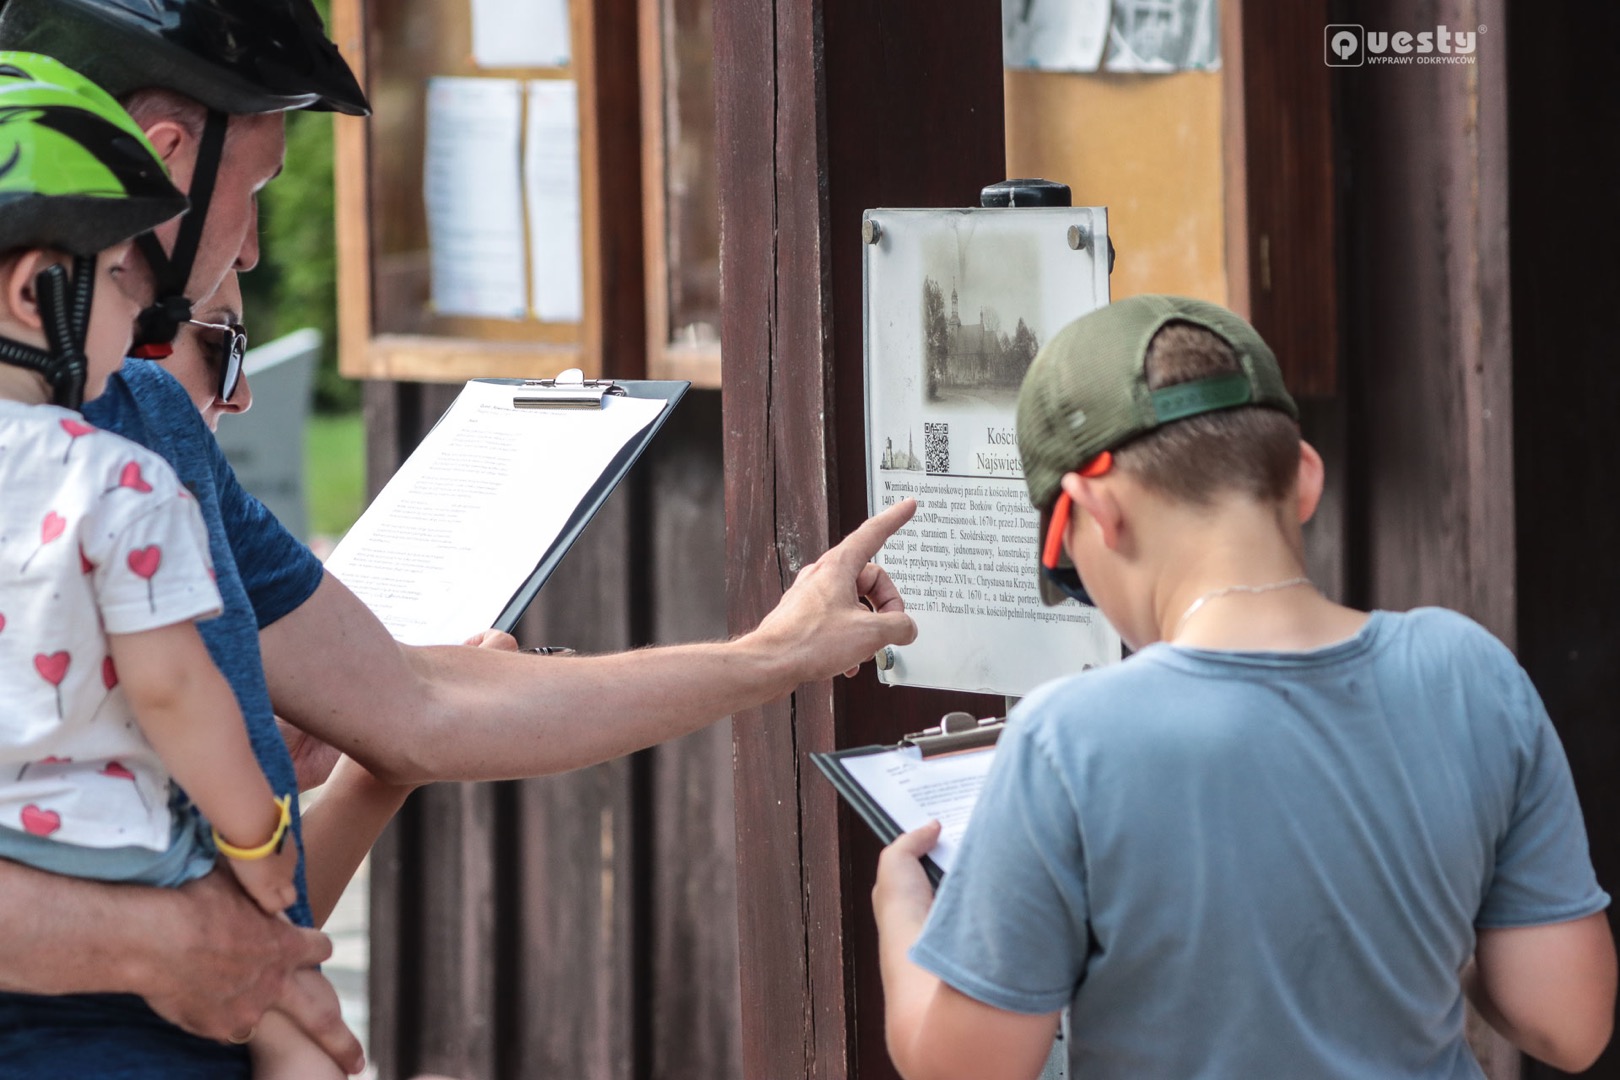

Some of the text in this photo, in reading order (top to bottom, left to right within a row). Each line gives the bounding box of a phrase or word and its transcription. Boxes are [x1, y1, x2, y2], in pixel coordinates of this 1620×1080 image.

[884, 482, 913, 492] Wzmianka
[919, 482, 963, 498] jednowioskowej
[965, 486, 983, 498] parafii
[989, 486, 1018, 498] kościołem
[928, 499, 947, 509] została
[951, 502, 966, 512] przez
[970, 500, 992, 510] Borków
[923, 513, 938, 523] NMP
[938, 514, 968, 525] wzniesiono
[979, 516, 993, 526] 1670
[999, 519, 1013, 530] przez
[921, 528, 947, 539] staraniem
[951, 529, 956, 539] E.
[907, 541, 917, 553] jest
[920, 542, 950, 556] drewniany,
[953, 544, 994, 559] jednonawowy,
[998, 546, 1030, 561] konstrukcji
[884, 554, 907, 568] Budowlę
[909, 557, 938, 570] przykrywa
[940, 559, 960, 571] wysoki
[961, 560, 976, 571] dach,
[983, 561, 994, 571] nad
[996, 562, 1019, 576] całością
[886, 570, 907, 583] najdują
[954, 573, 966, 584] XVI
[977, 575, 1005, 589] Chrystusa
[900, 585, 922, 596] odrzwia
[924, 587, 947, 599] zakrystii
[968, 590, 982, 600] 1670
[993, 593, 997, 602] a
[999, 592, 1014, 602] także
[942, 603, 964, 614] Podczas
[987, 606, 1007, 617] kościół
[1008, 608, 1024, 620] pełnił
[1025, 609, 1036, 622] rolę
[1036, 612, 1066, 623] magazynu
